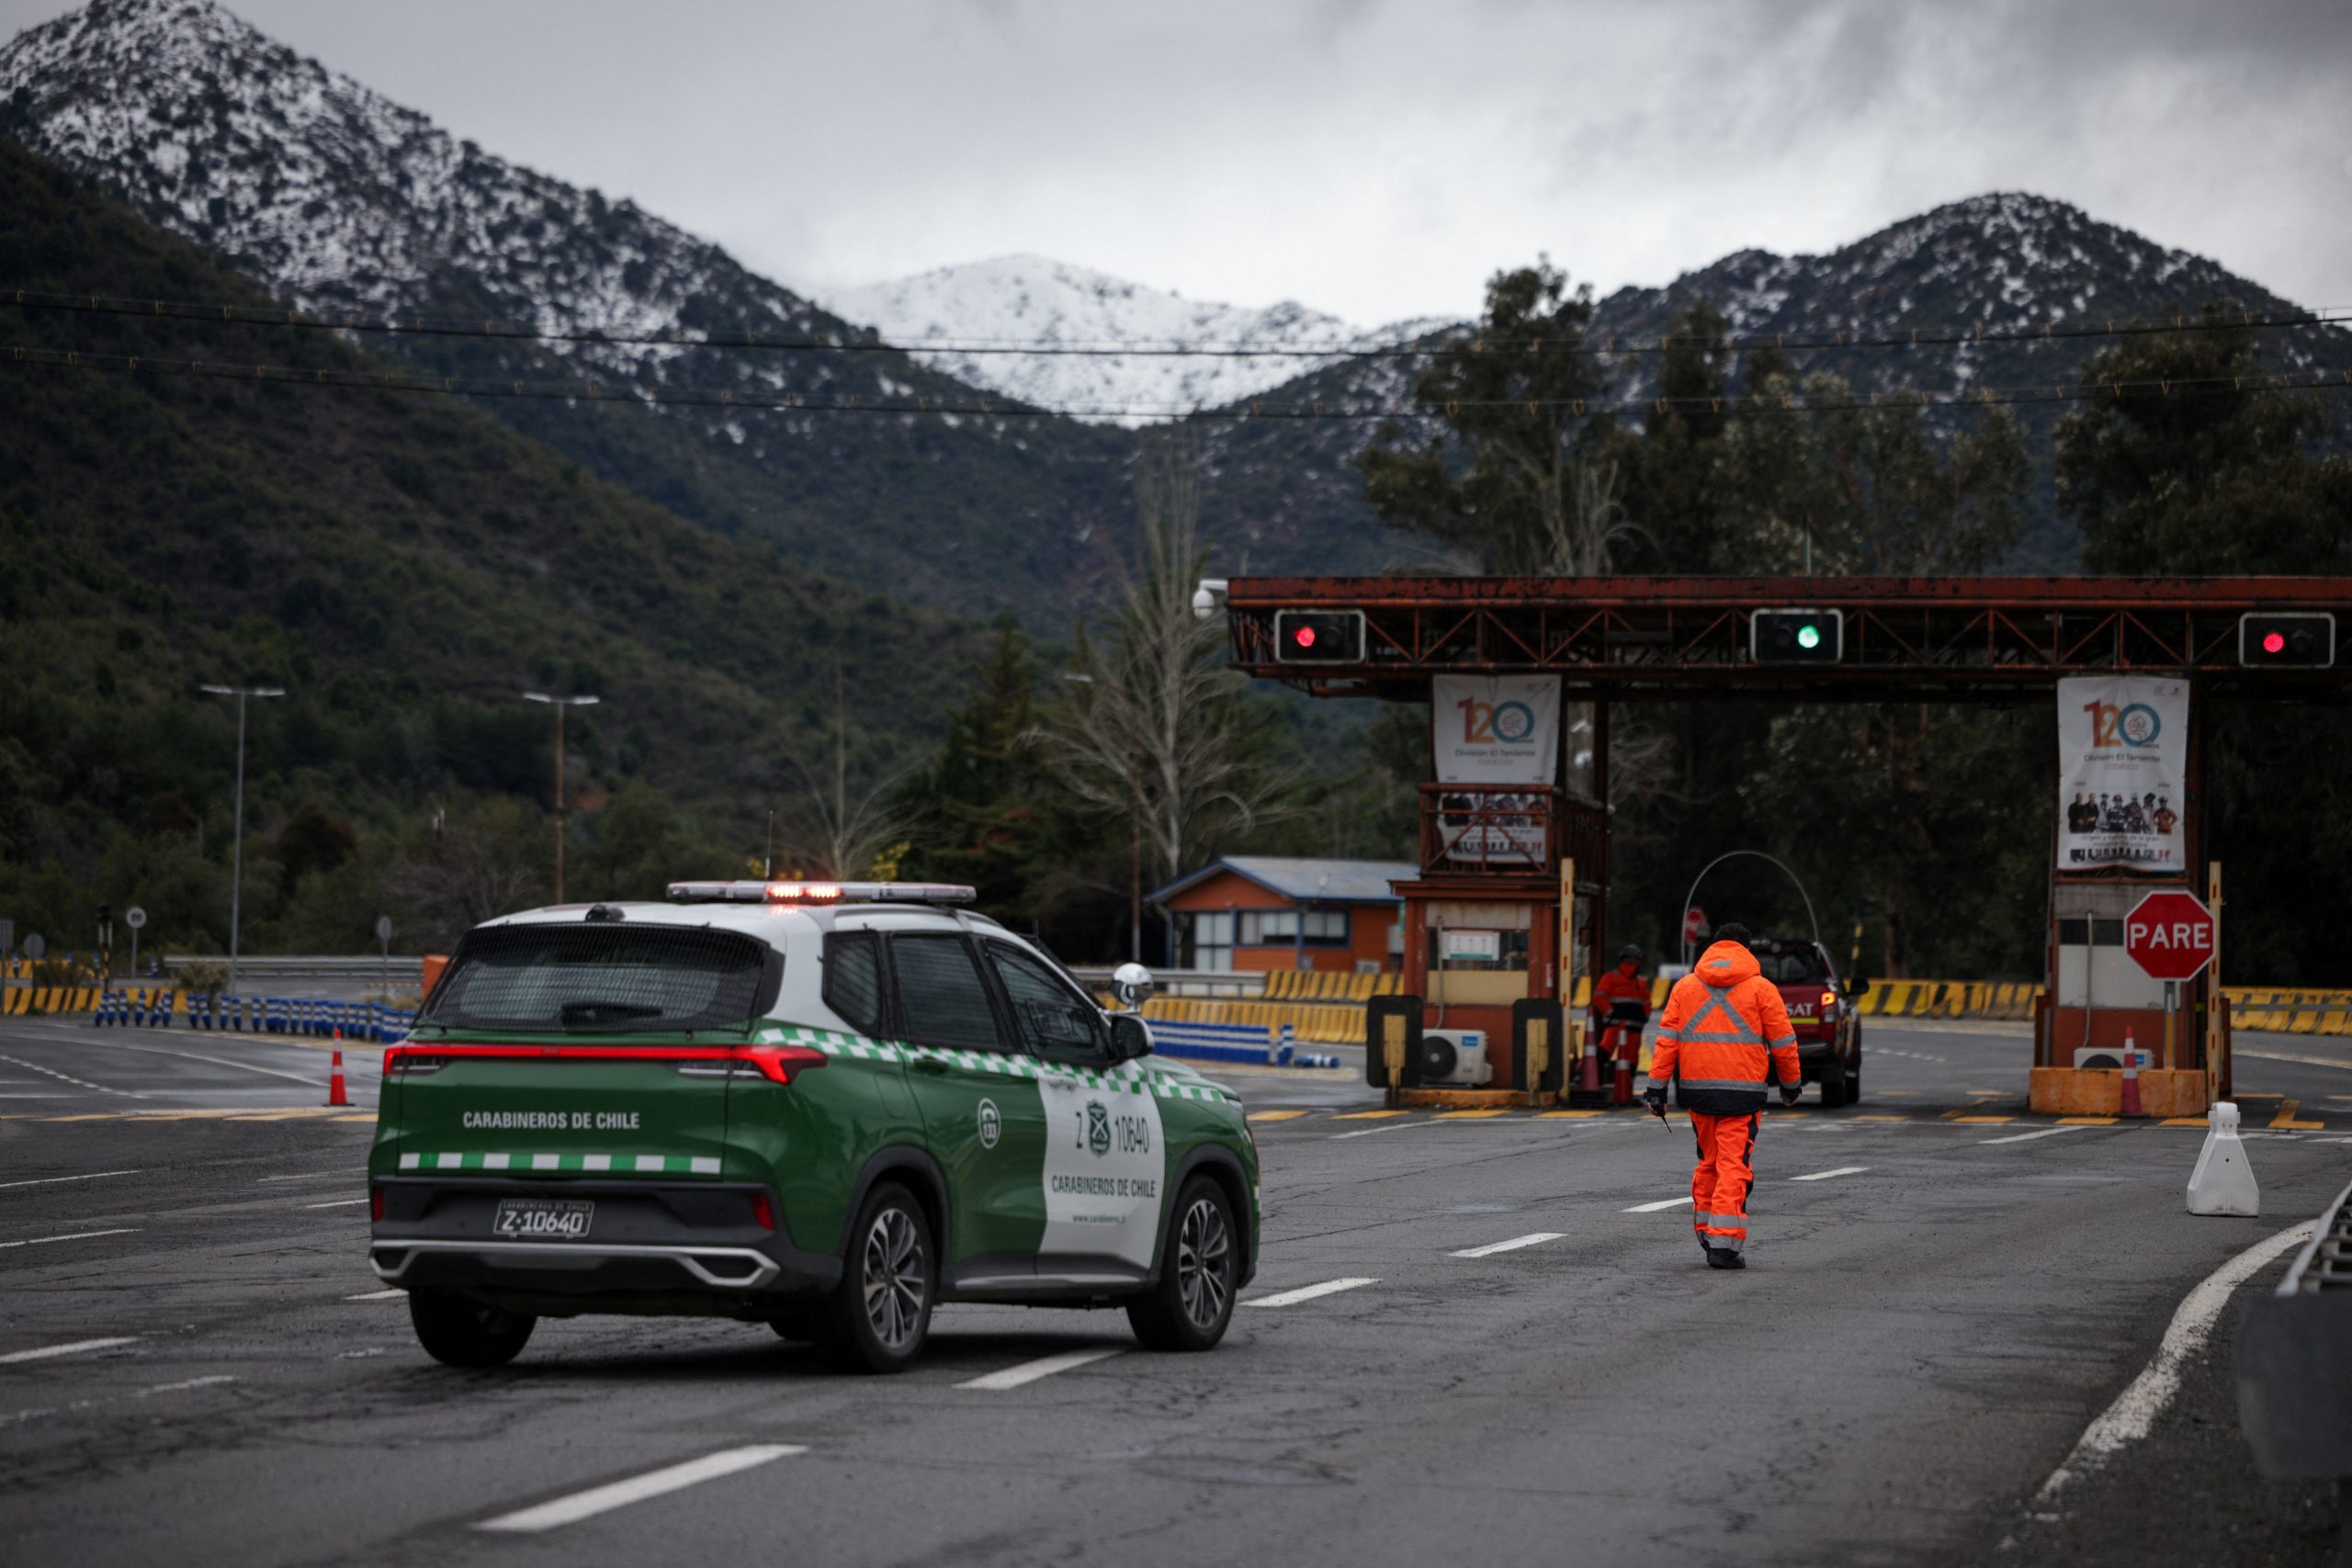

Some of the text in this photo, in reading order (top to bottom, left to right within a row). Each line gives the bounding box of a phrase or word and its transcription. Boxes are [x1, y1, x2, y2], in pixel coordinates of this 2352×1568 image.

[1456, 695, 1534, 744] 120
[2084, 698, 2161, 748] 120
[2084, 752, 2161, 763] División El Teniente
[2129, 922, 2211, 950] PARE
[463, 1111, 640, 1130] CARABINEROS DE CHILE
[1075, 1111, 1150, 1154] Z 10640
[1052, 1175, 1157, 1198] CARABINEROS DE CHILE
